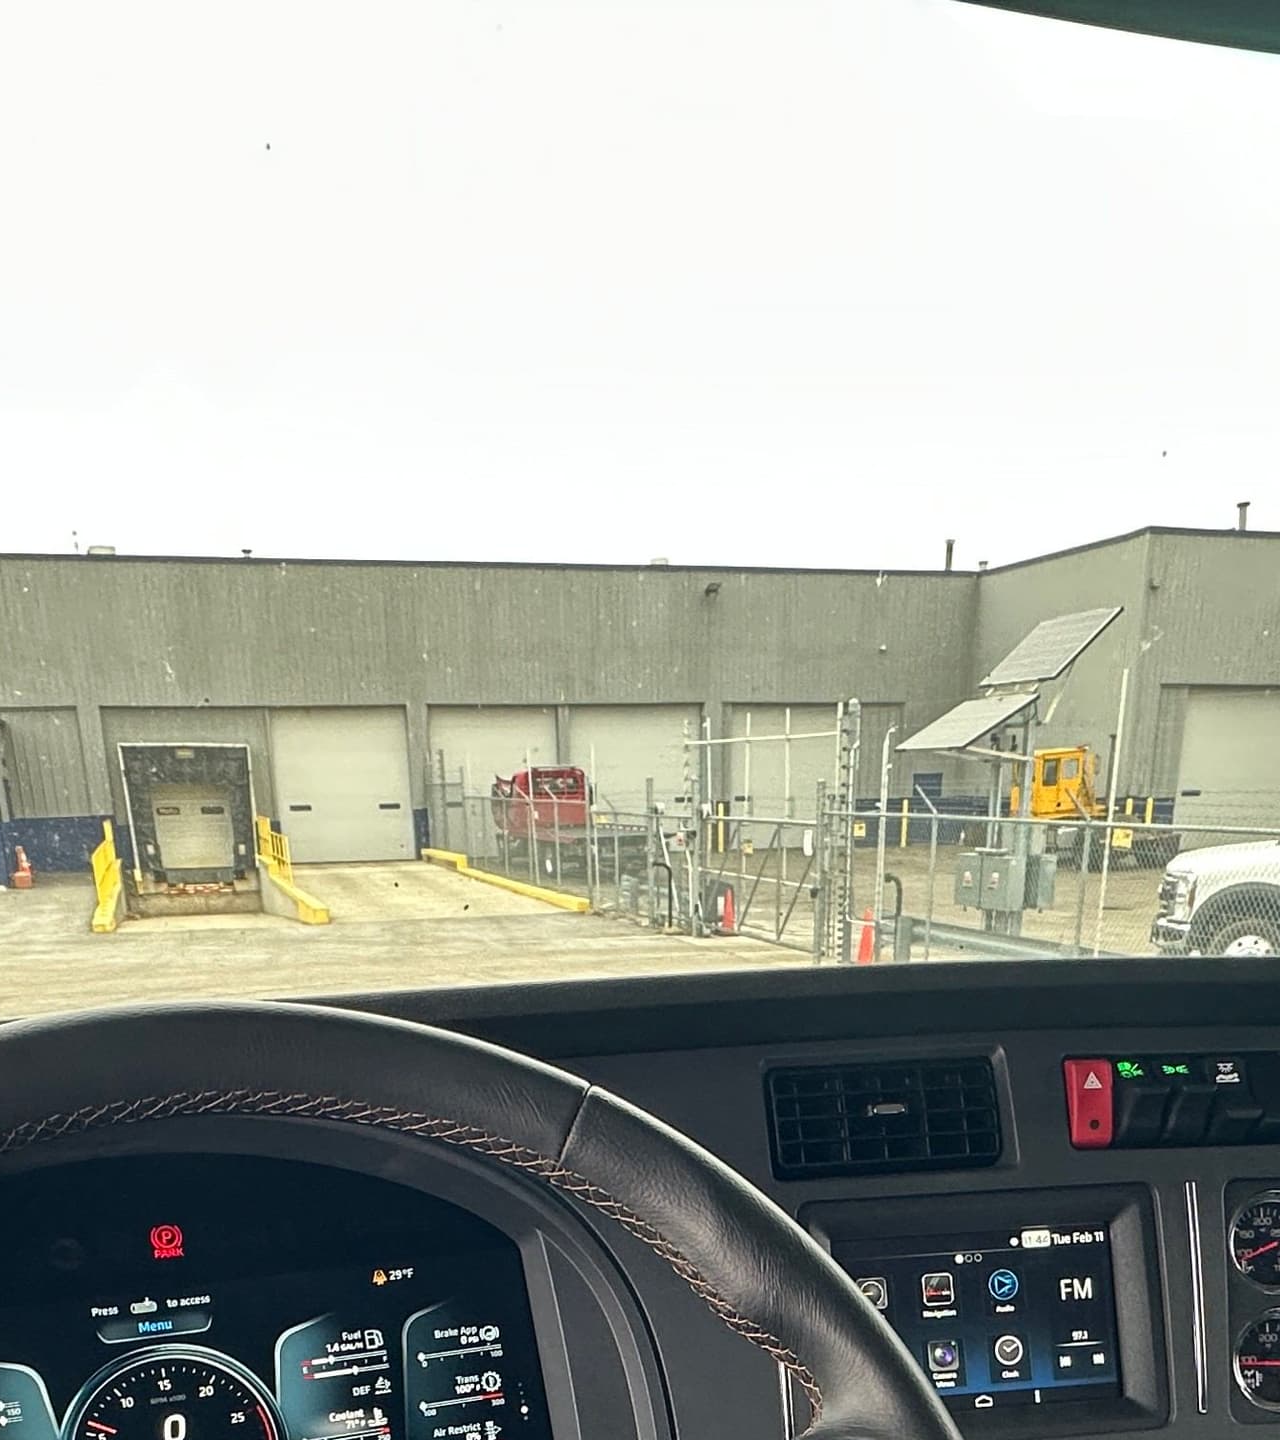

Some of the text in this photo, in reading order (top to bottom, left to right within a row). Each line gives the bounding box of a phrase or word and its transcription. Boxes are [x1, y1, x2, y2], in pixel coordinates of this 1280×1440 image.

[1052, 1233, 1071, 1245] Tue
[1073, 1231, 1092, 1244] Feb
[1094, 1231, 1104, 1242] 11
[154, 1247, 185, 1259] PARK
[1060, 1277, 1093, 1300] FM
[91, 1295, 211, 1317] Press to access
[138, 1320, 173, 1333] Menu
[342, 1330, 362, 1341] Fuel
[434, 1326, 478, 1340] Brake App
[157, 1380, 172, 1391] 15
[455, 1374, 479, 1385] Trans
[199, 1386, 214, 1397] 20
[352, 1385, 371, 1397] DEF
[120, 1397, 134, 1408] 10
[230, 1412, 245, 1424] 25
[328, 1408, 365, 1423] Coolant
[433, 1422, 481, 1438] Air Restrict
